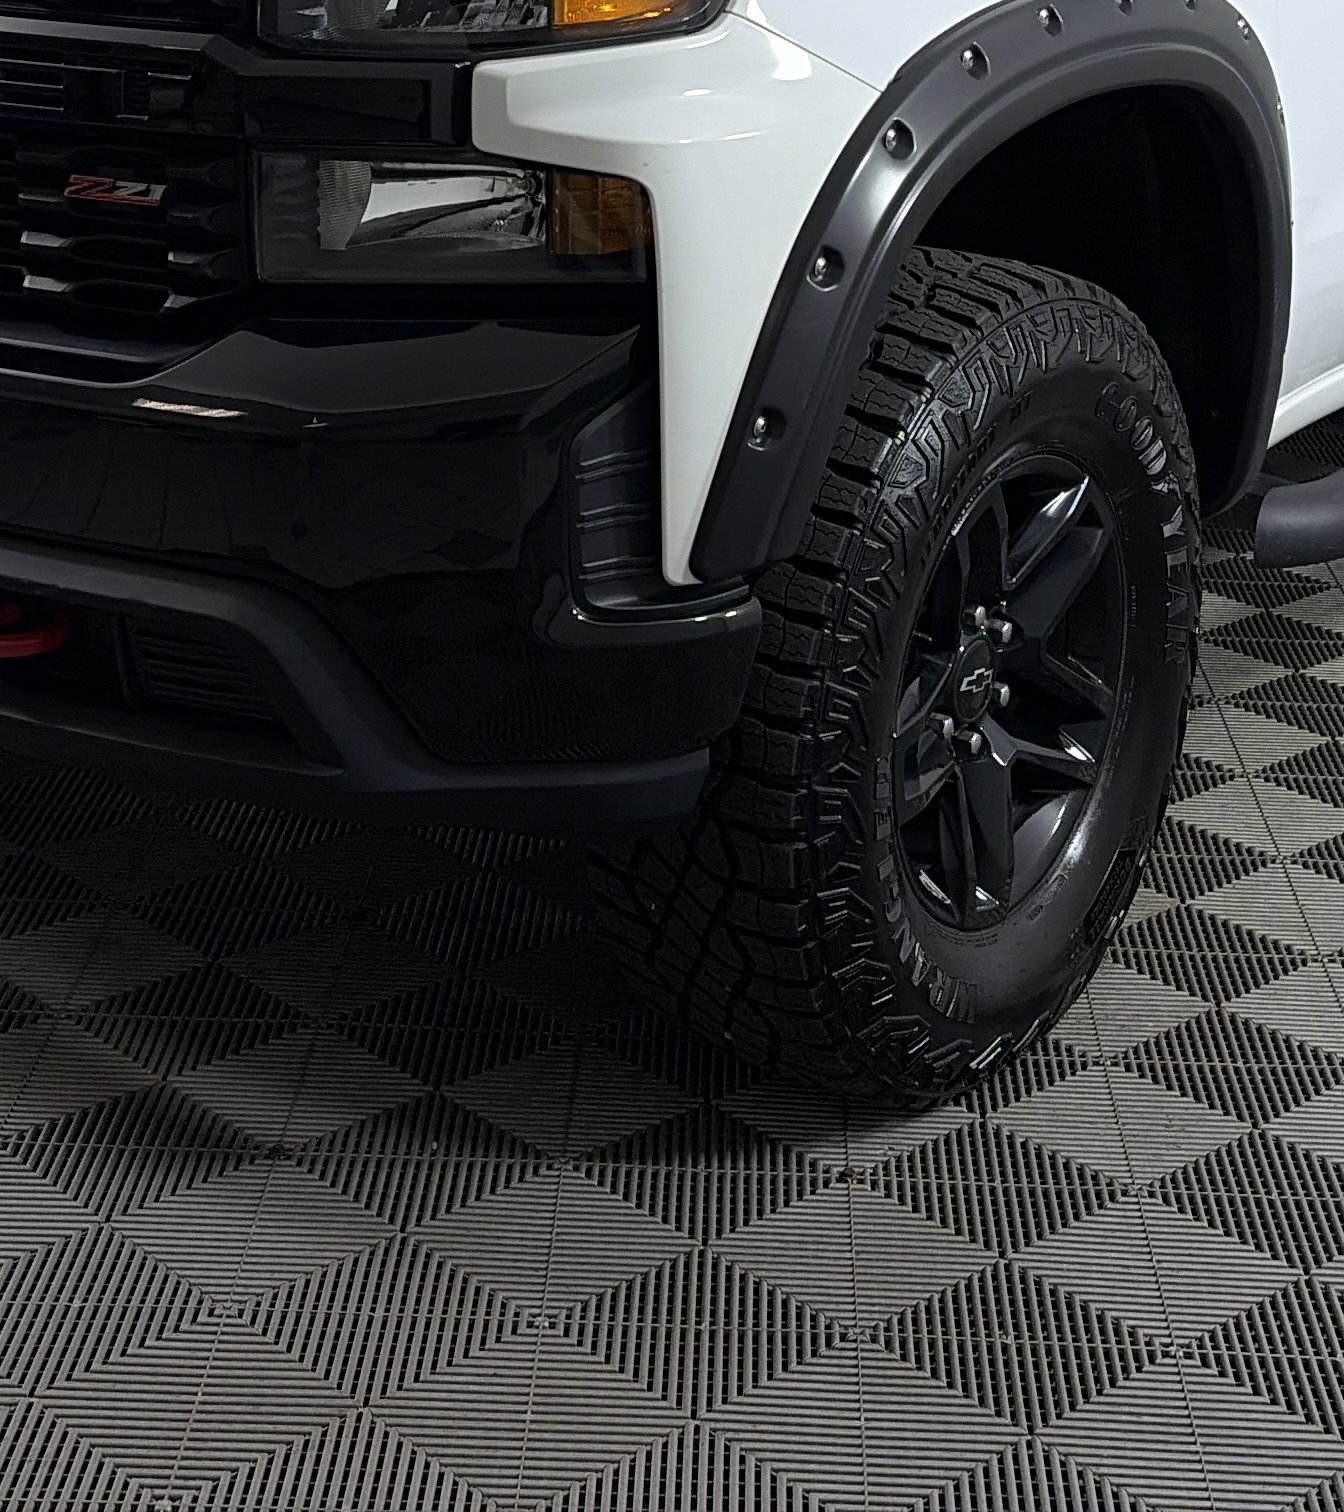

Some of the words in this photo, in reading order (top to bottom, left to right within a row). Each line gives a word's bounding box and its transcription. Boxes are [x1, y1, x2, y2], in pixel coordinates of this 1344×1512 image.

[64, 174, 169, 206] Z71
[1094, 382, 1190, 665] GOODYEAR
[873, 753, 978, 1025] WRANGLER
